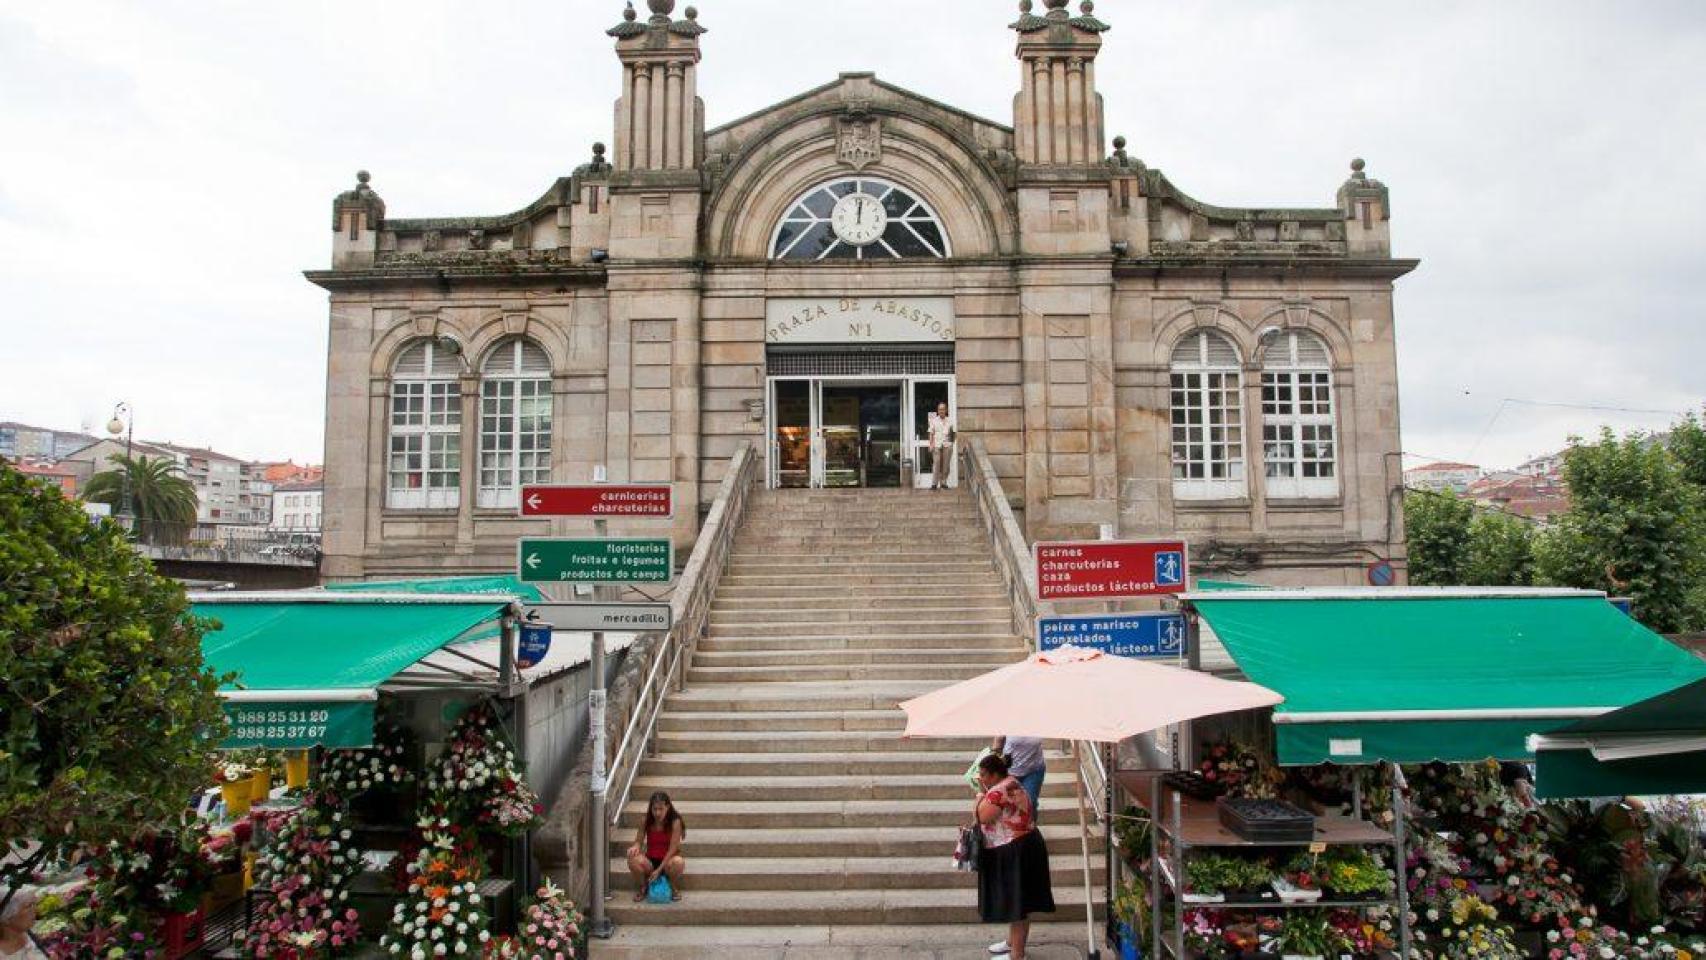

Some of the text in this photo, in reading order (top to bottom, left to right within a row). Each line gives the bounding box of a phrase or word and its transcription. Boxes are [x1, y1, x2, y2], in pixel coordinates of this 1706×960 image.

[768, 298, 953, 341] PRAZA DE ABASTOS
[1041, 548, 1083, 557] carnes
[571, 554, 666, 567] froitas e legumes
[1042, 559, 1120, 570] charcuterias
[560, 569, 665, 580] productos do campo
[1042, 573, 1071, 582] caza
[1043, 580, 1156, 595] productos lácteos
[603, 612, 665, 623] mercadillo
[1043, 619, 1139, 634] peixe e marisco
[1044, 633, 1112, 645] conxelados
[1110, 642, 1156, 654] lácteos
[237, 710, 329, 724] 988 25 31 20
[236, 725, 327, 739] 988 25 37 67
